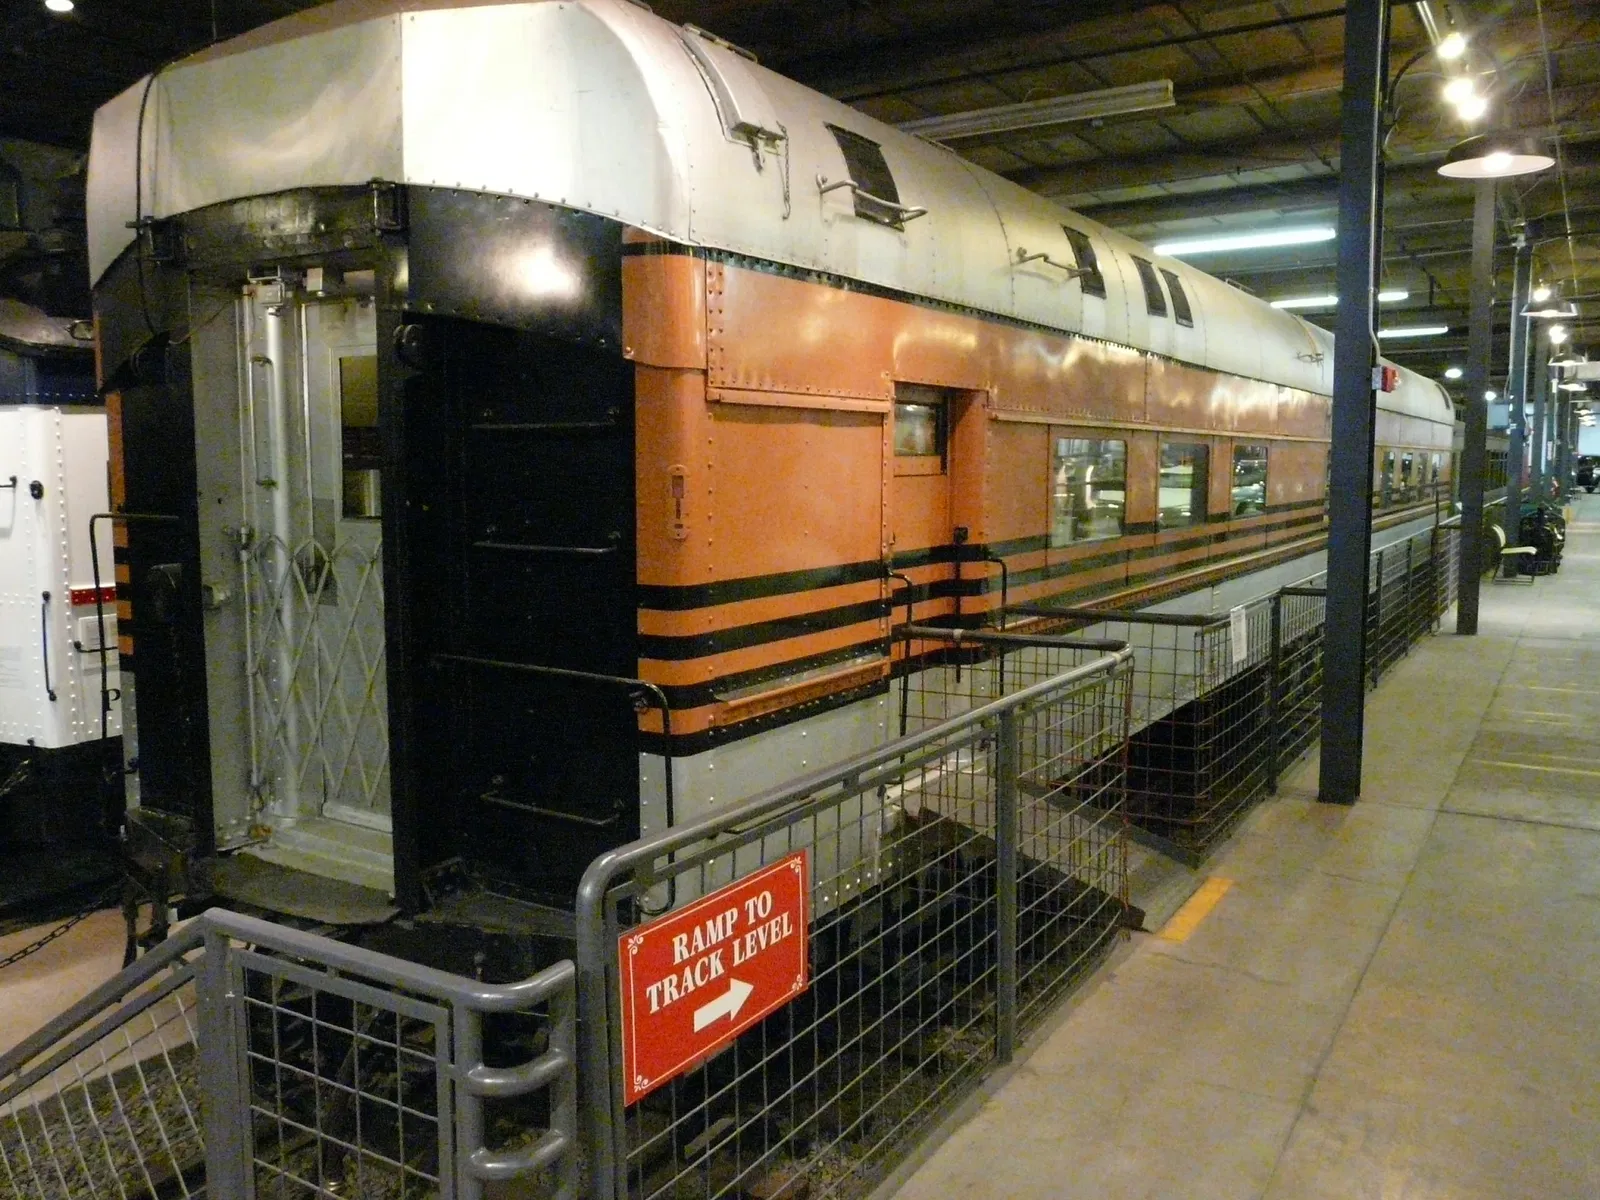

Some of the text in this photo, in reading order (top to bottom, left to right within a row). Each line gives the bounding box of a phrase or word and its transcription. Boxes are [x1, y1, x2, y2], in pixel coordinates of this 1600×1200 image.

[646, 911, 793, 1015] TRACK LEVEL
[672, 890, 772, 966] RAMP TO
